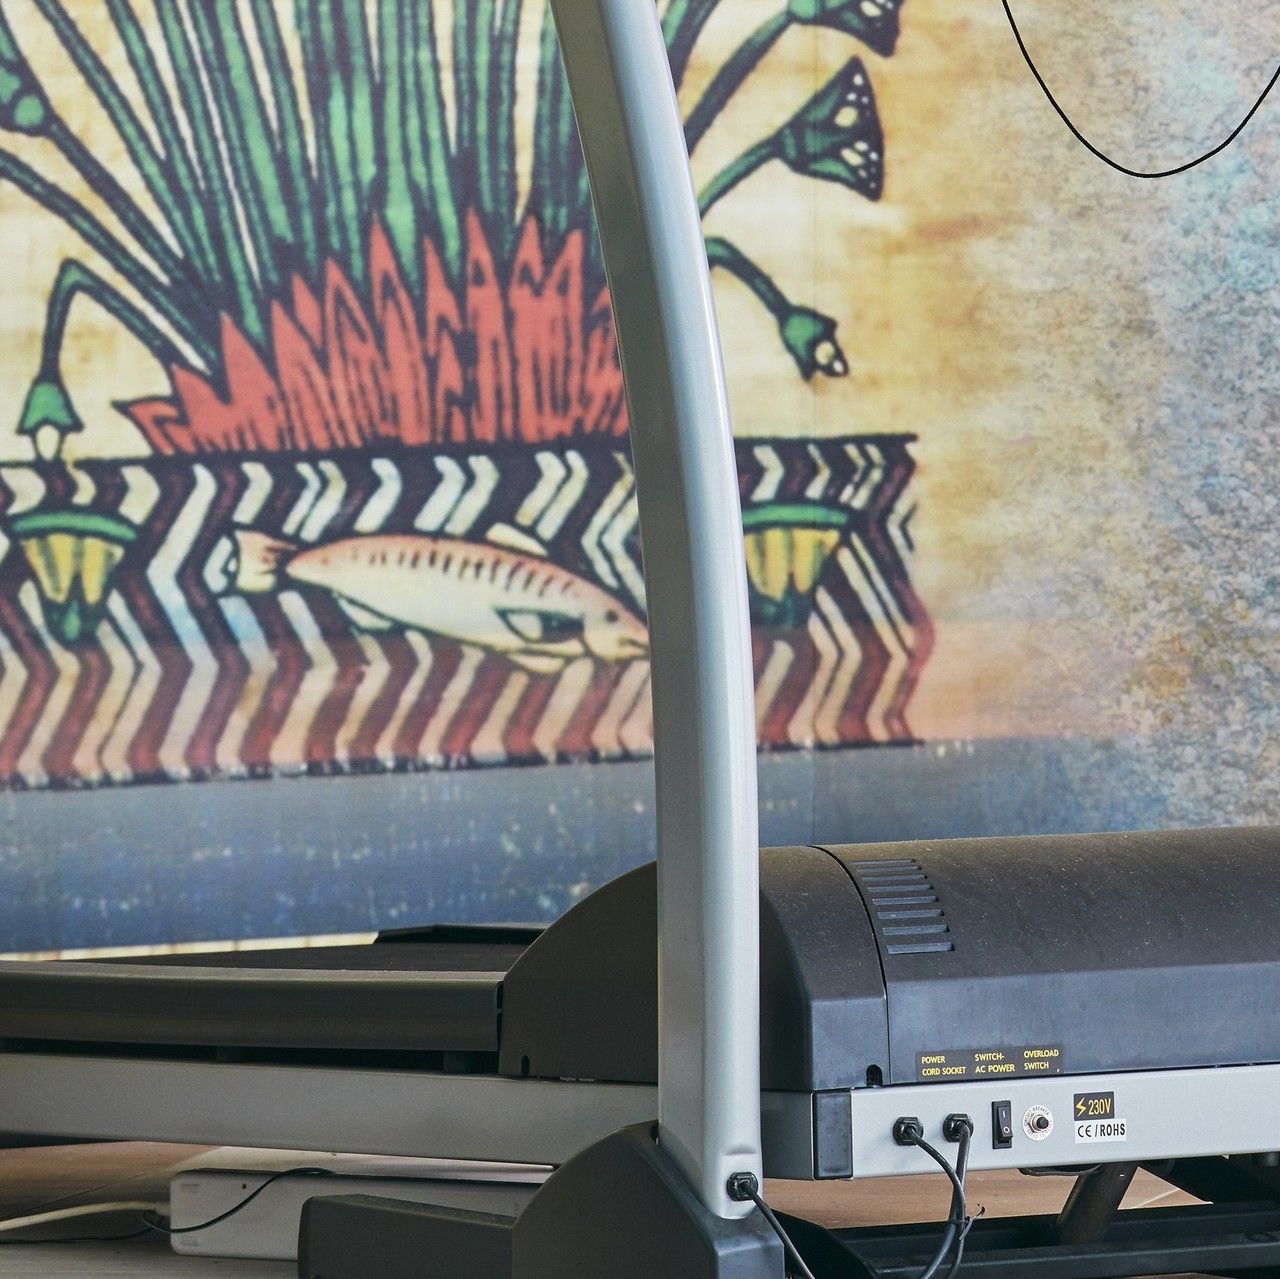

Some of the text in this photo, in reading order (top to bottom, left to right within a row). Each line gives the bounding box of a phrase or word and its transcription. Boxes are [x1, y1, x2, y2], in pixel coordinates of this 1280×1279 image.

[975, 1053, 1005, 1061] SWITCH-
[1024, 1050, 1059, 1059] OVERLOAD
[922, 1056, 946, 1064] POWER
[975, 1064, 1016, 1074] AC POWER
[1024, 1062, 1049, 1071] SWITCH
[922, 1067, 966, 1076] CORD SOCKET
[1088, 1098, 1111, 1115] 230V
